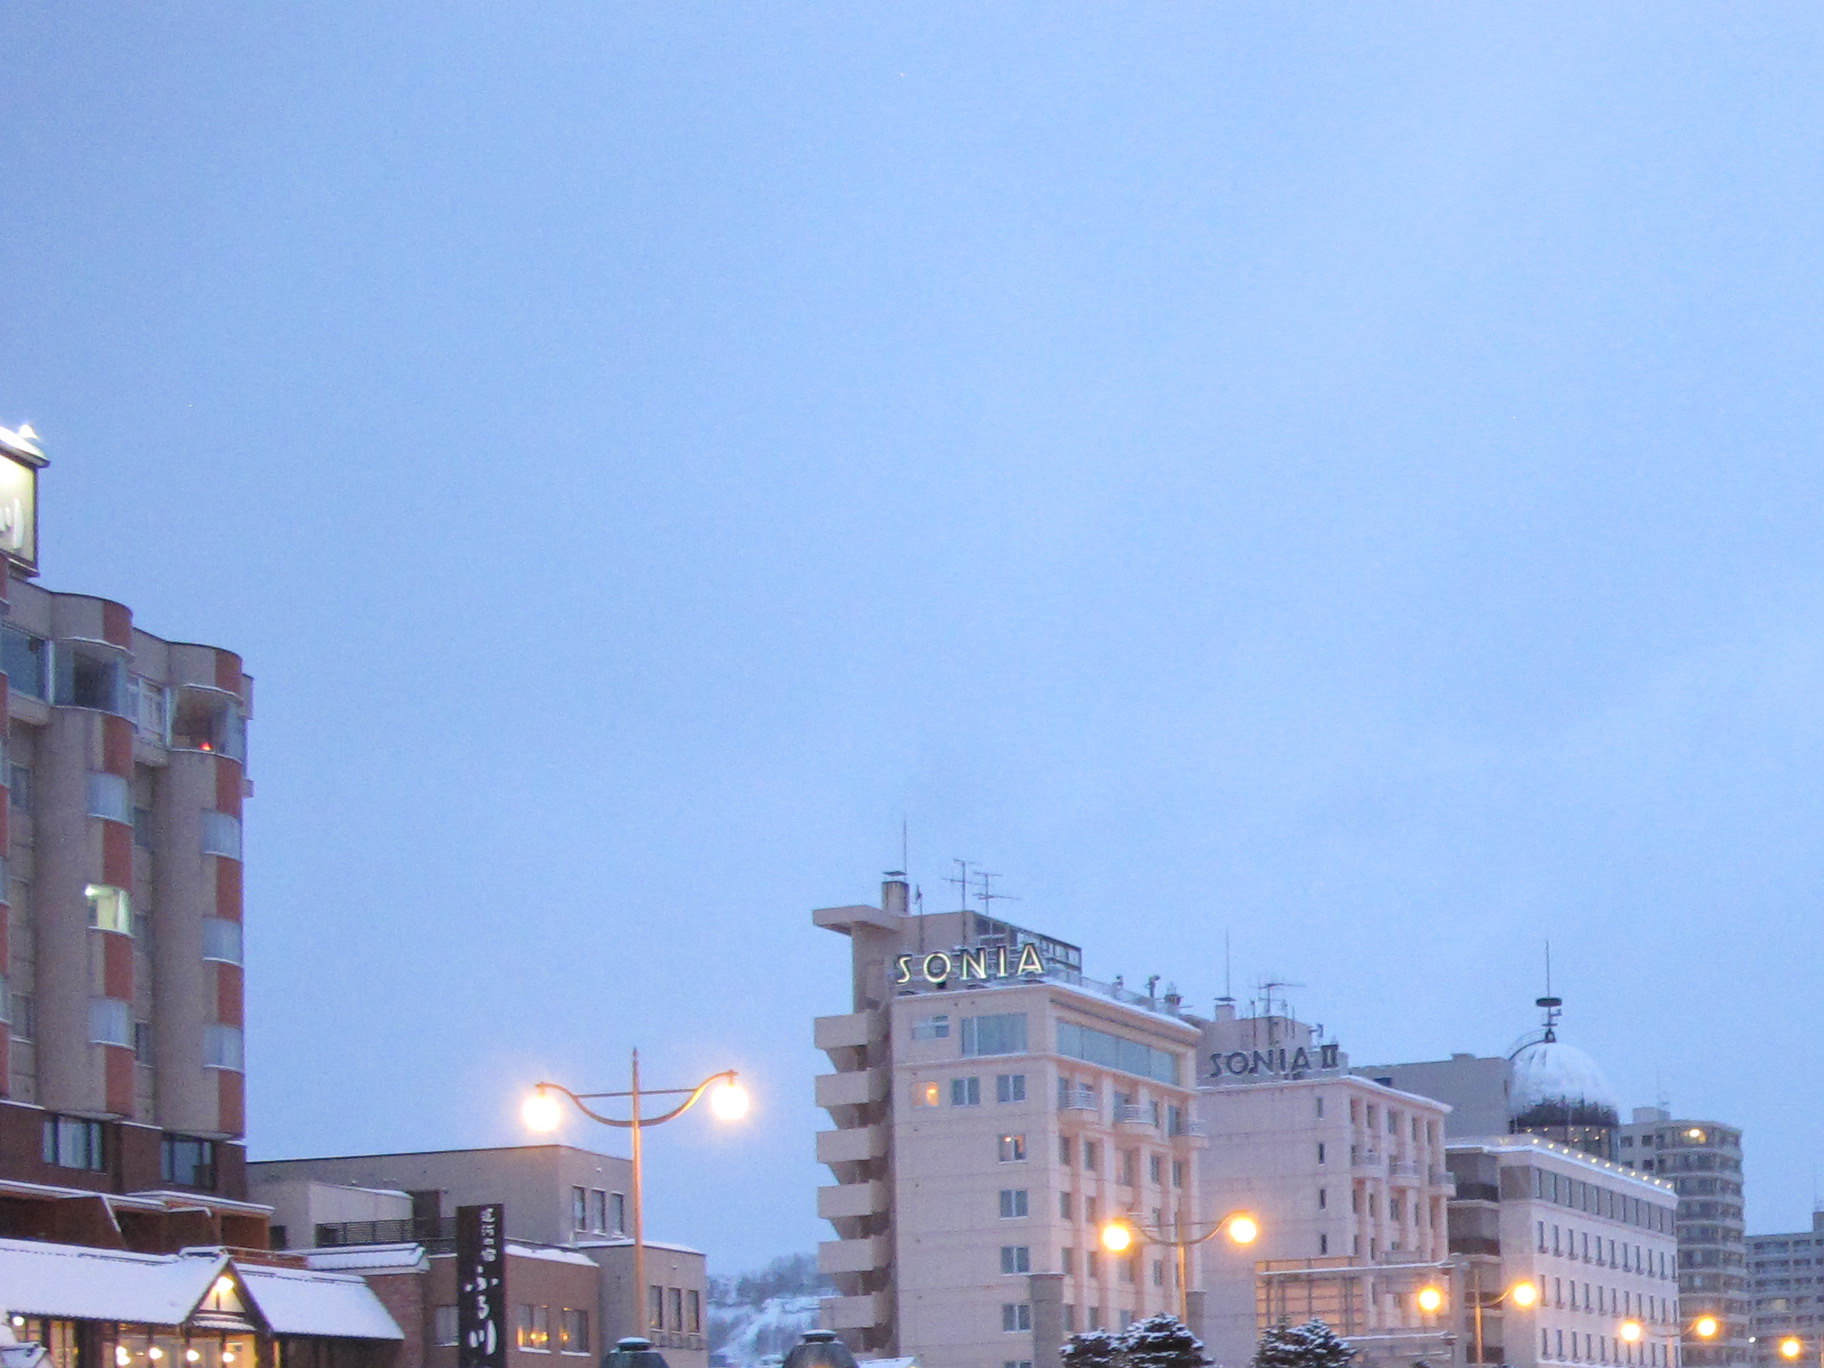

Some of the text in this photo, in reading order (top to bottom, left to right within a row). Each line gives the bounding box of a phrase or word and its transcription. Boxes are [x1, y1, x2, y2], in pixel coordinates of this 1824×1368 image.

[897, 943, 1045, 985] SONIA
[1210, 1047, 1311, 1078] SONIA
[464, 1265, 499, 1355] ふる川
